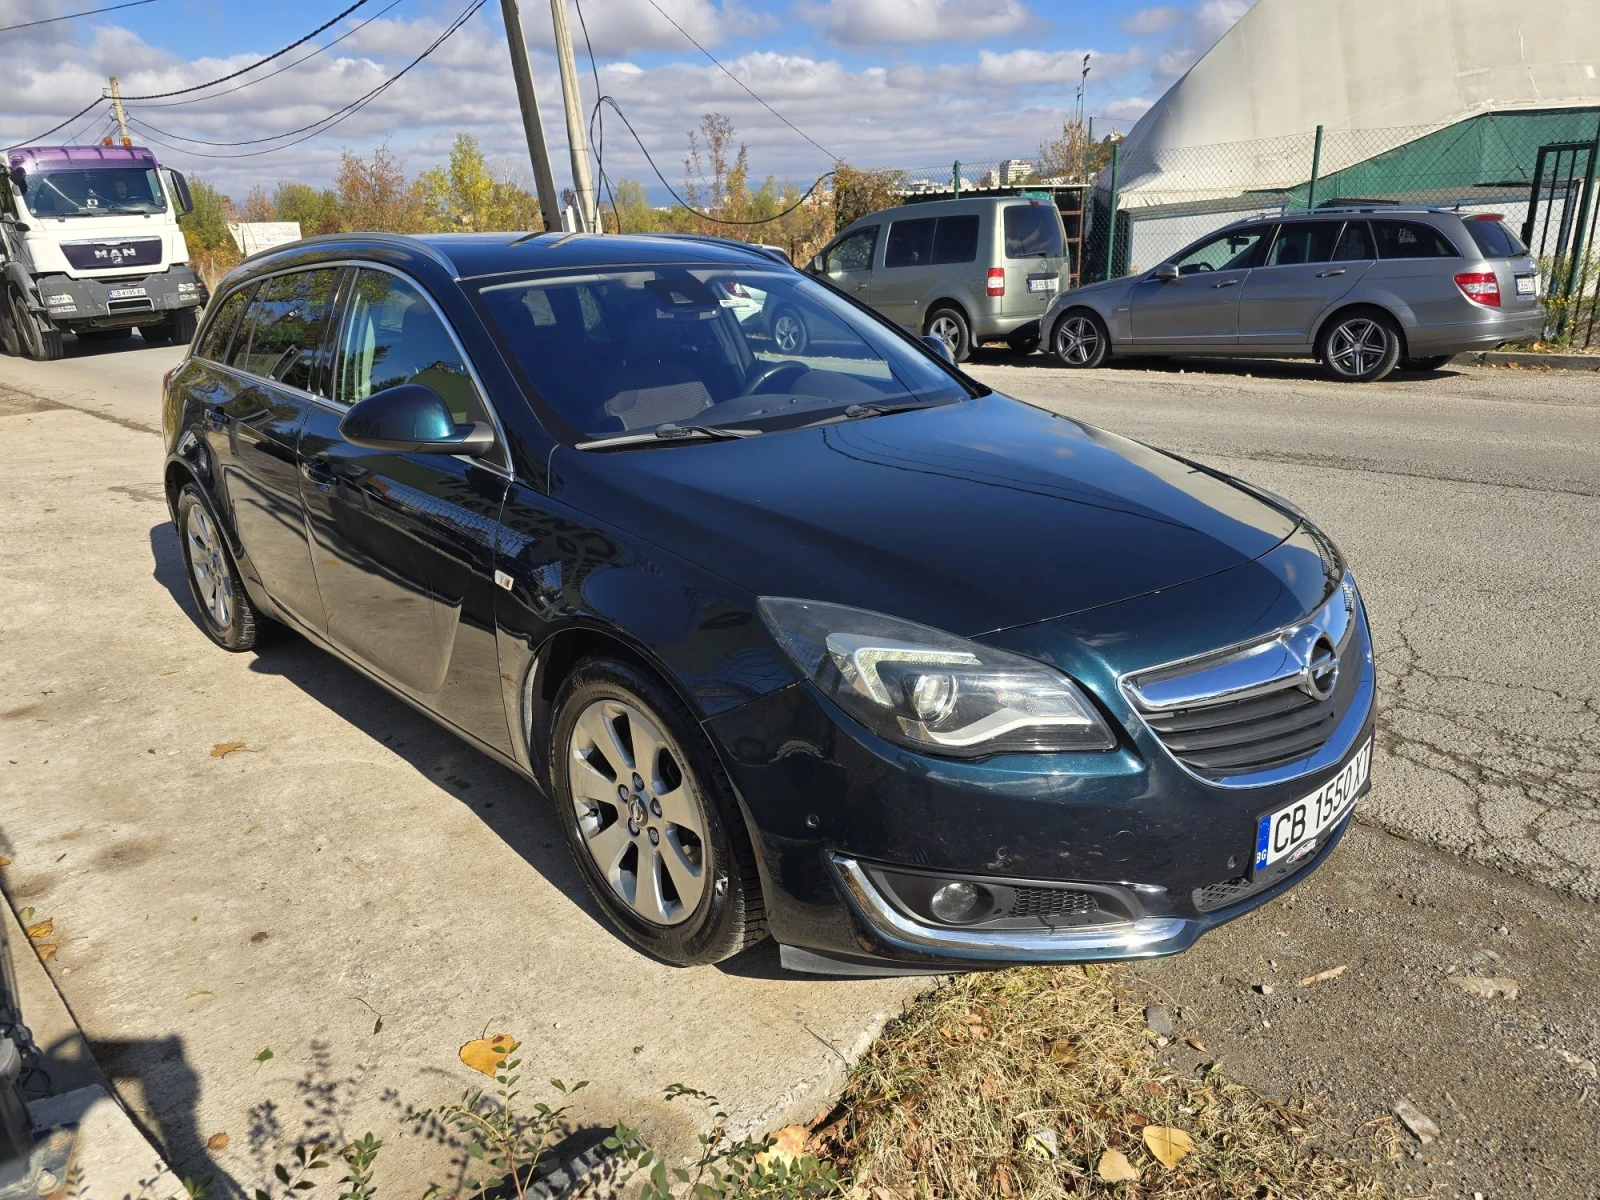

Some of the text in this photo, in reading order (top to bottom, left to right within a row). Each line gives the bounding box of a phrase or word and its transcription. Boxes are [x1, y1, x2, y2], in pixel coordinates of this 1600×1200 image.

[94, 248, 136, 259] MAN
[1273, 803, 1307, 854] CB
[1315, 765, 1352, 829] 1550
[1256, 848, 1267, 865] BG
